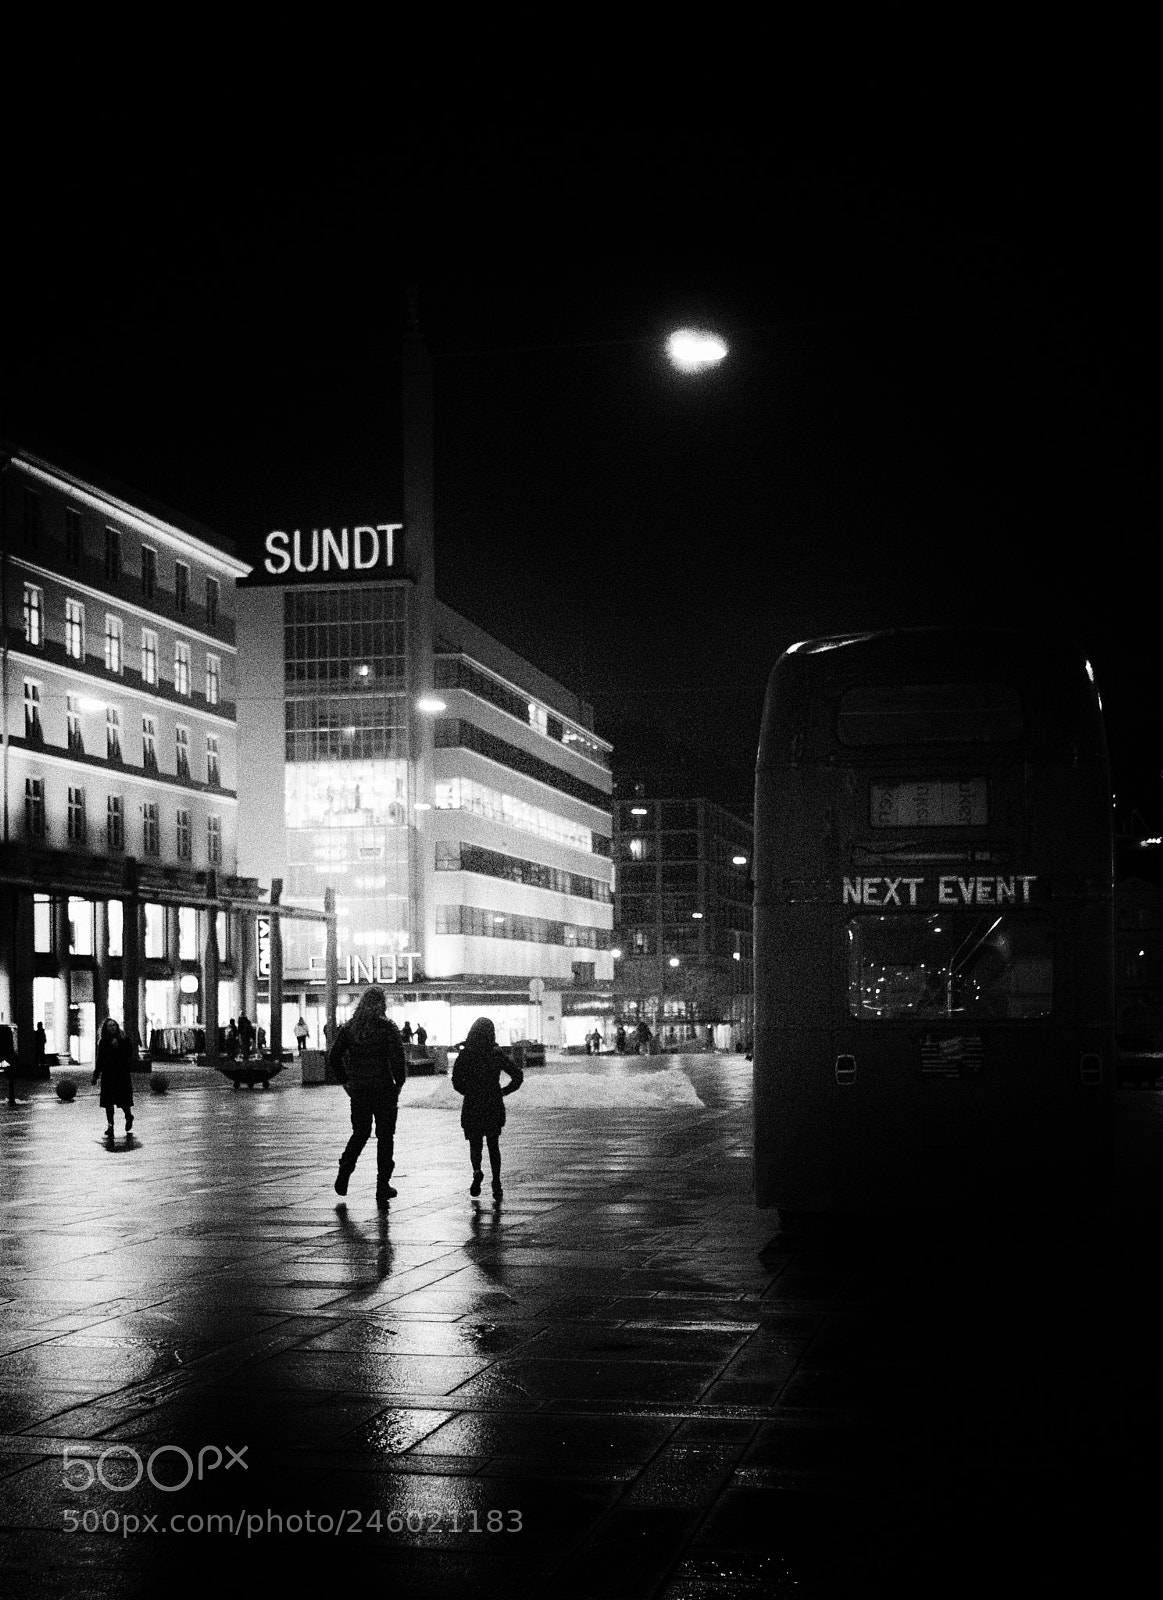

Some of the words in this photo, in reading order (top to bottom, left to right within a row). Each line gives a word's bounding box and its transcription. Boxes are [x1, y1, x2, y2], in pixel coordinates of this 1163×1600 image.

[264, 523, 403, 574] SUNDT
[842, 876, 925, 905] NEXT
[938, 875, 1038, 904] EVENT
